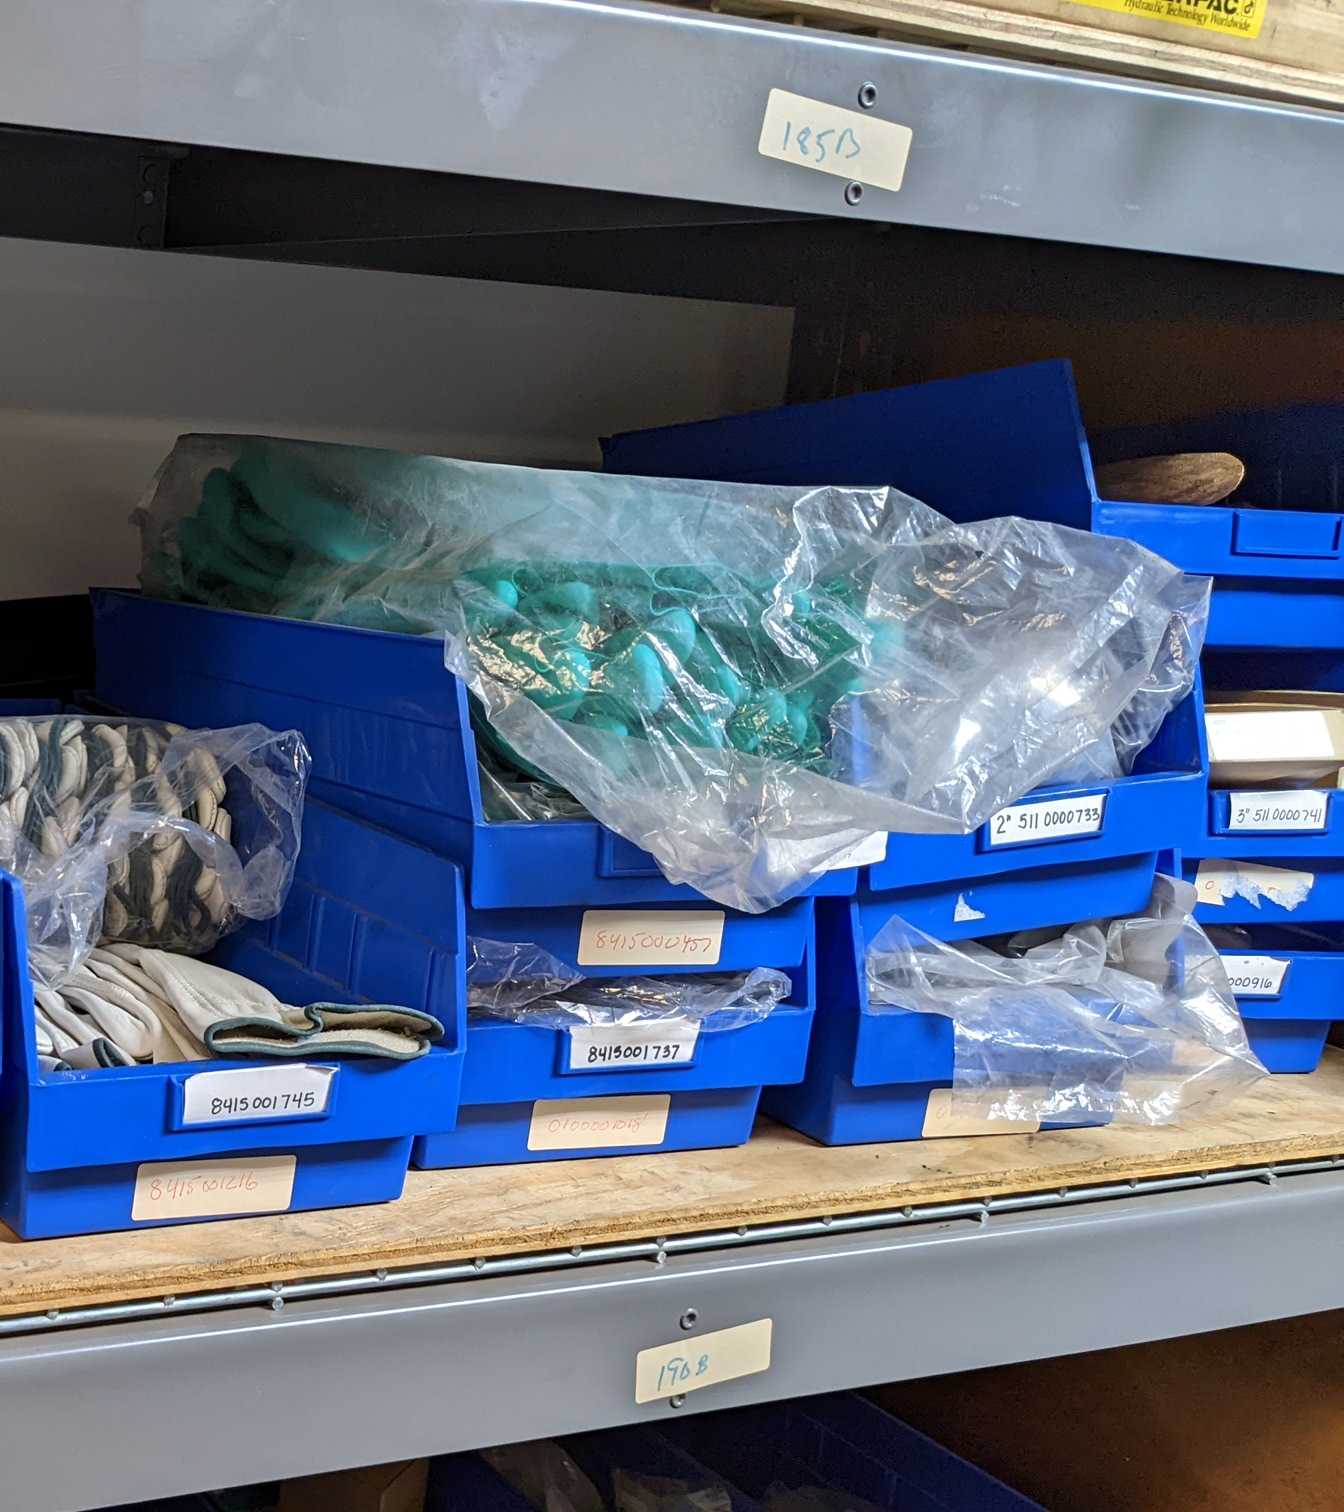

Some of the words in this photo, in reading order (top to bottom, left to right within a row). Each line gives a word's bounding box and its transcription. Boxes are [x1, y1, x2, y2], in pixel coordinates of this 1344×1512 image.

[782, 121, 862, 162] 185B
[1018, 813, 1038, 829] 511
[1044, 808, 1100, 827] 0000733
[1253, 807, 1270, 822] 511
[587, 1044, 680, 1063] 8415001737
